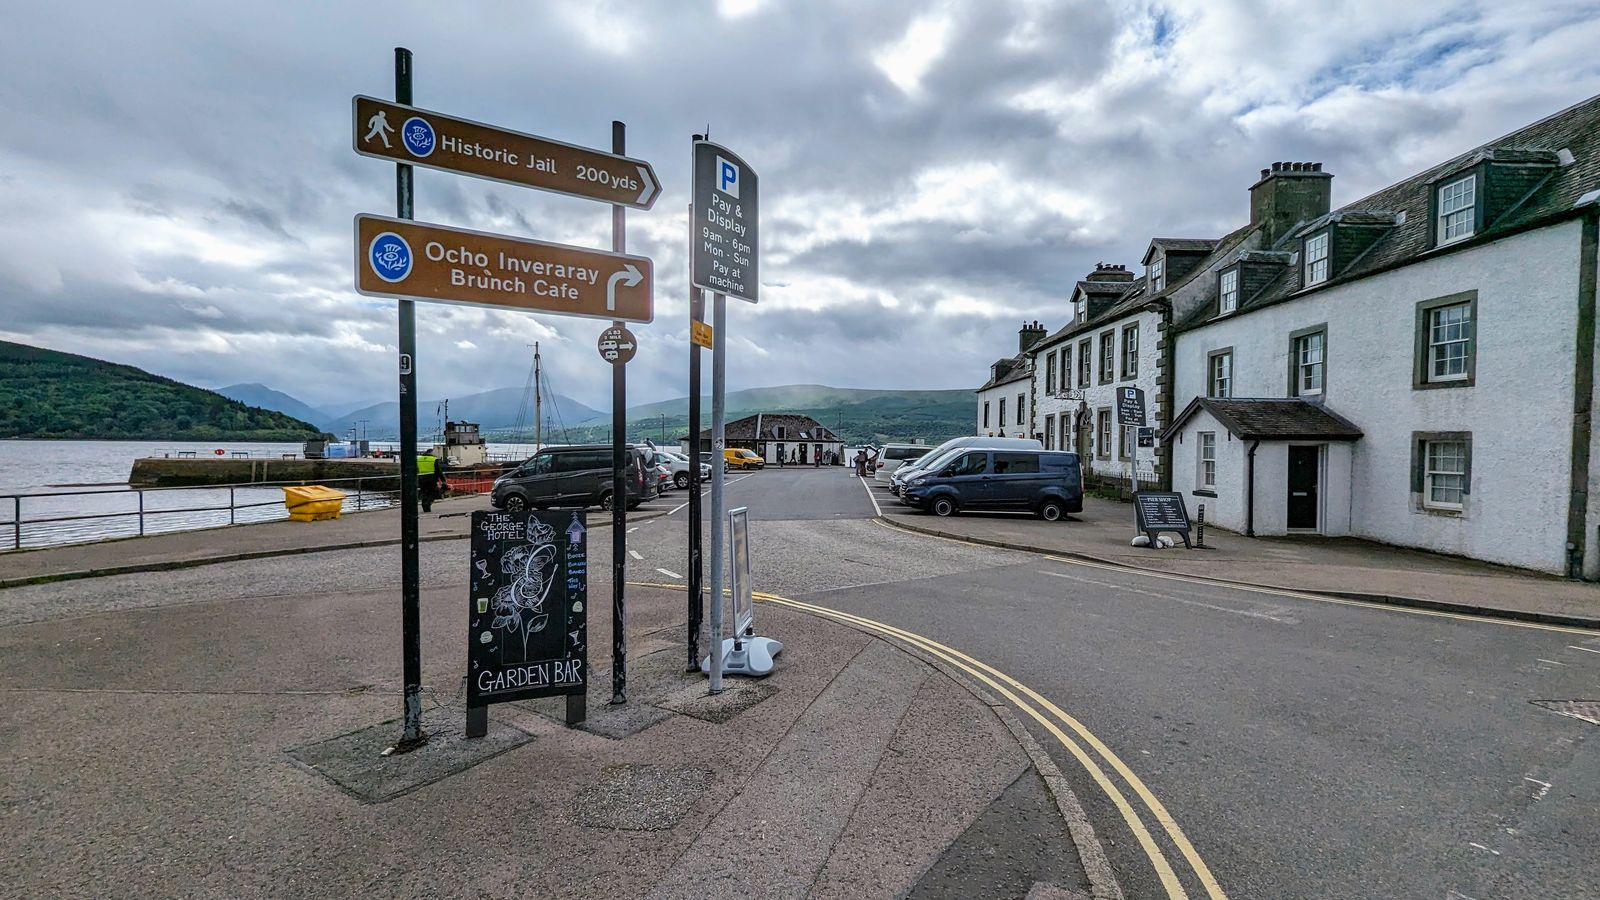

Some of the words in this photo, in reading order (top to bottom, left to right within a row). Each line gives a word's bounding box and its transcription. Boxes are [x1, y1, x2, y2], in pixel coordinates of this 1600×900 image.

[442, 135, 518, 166] Historic
[526, 155, 557, 174] Jail
[722, 161, 736, 191] P
[712, 193, 732, 215] Pay
[735, 204, 743, 219] &
[708, 209, 746, 237] Display
[703, 226, 722, 244] 9am
[732, 238, 751, 255] 6pm
[425, 241, 488, 267] Ocho
[500, 252, 599, 285] Inveraray
[704, 242, 723, 258] Mon
[733, 252, 749, 267] Sun
[713, 260, 729, 277] Pay
[732, 267, 741, 279] at
[451, 268, 525, 294] Brunch
[533, 280, 579, 300] Cafe
[709, 274, 744, 293] machine
[481, 521, 524, 531] GEORGE
[487, 513, 510, 522] THE
[487, 530, 524, 540] HOTEL
[478, 663, 549, 692] GARDEN
[554, 659, 583, 683] BAR
